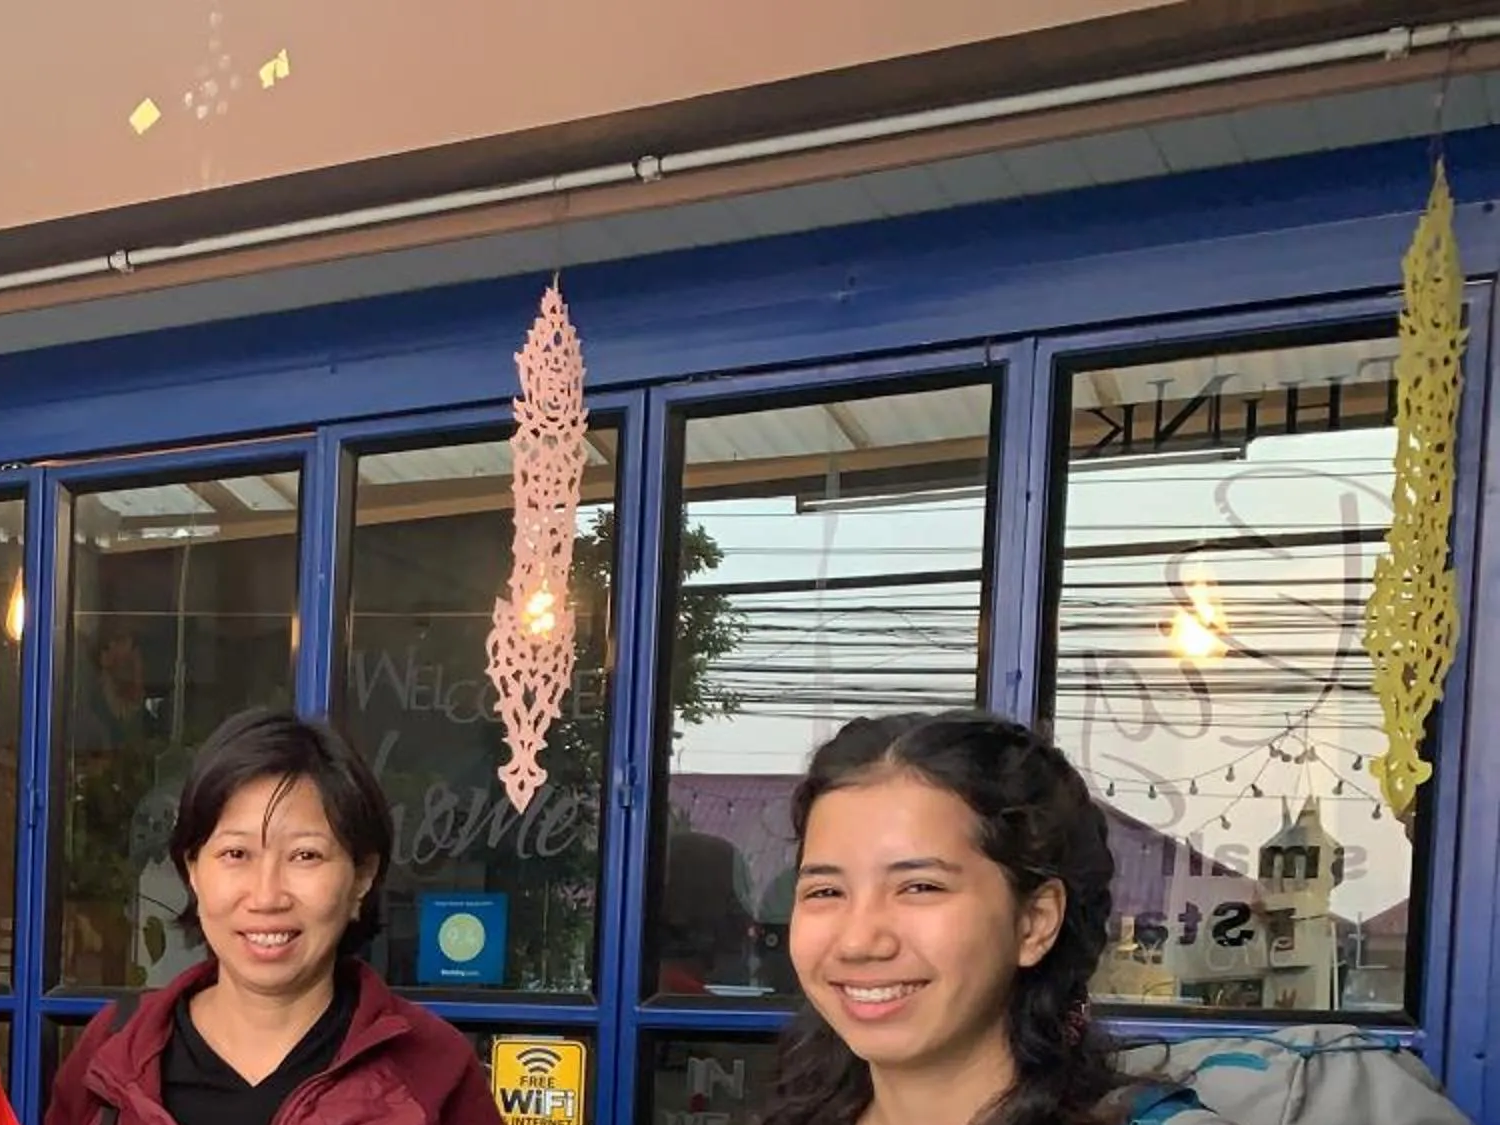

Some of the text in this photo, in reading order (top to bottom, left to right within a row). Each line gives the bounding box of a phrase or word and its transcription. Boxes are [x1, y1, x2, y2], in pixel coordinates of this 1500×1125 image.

[352, 644, 598, 724] WELCE
[519, 1075, 557, 1088] FREE
[500, 1087, 576, 1119] WiFi
